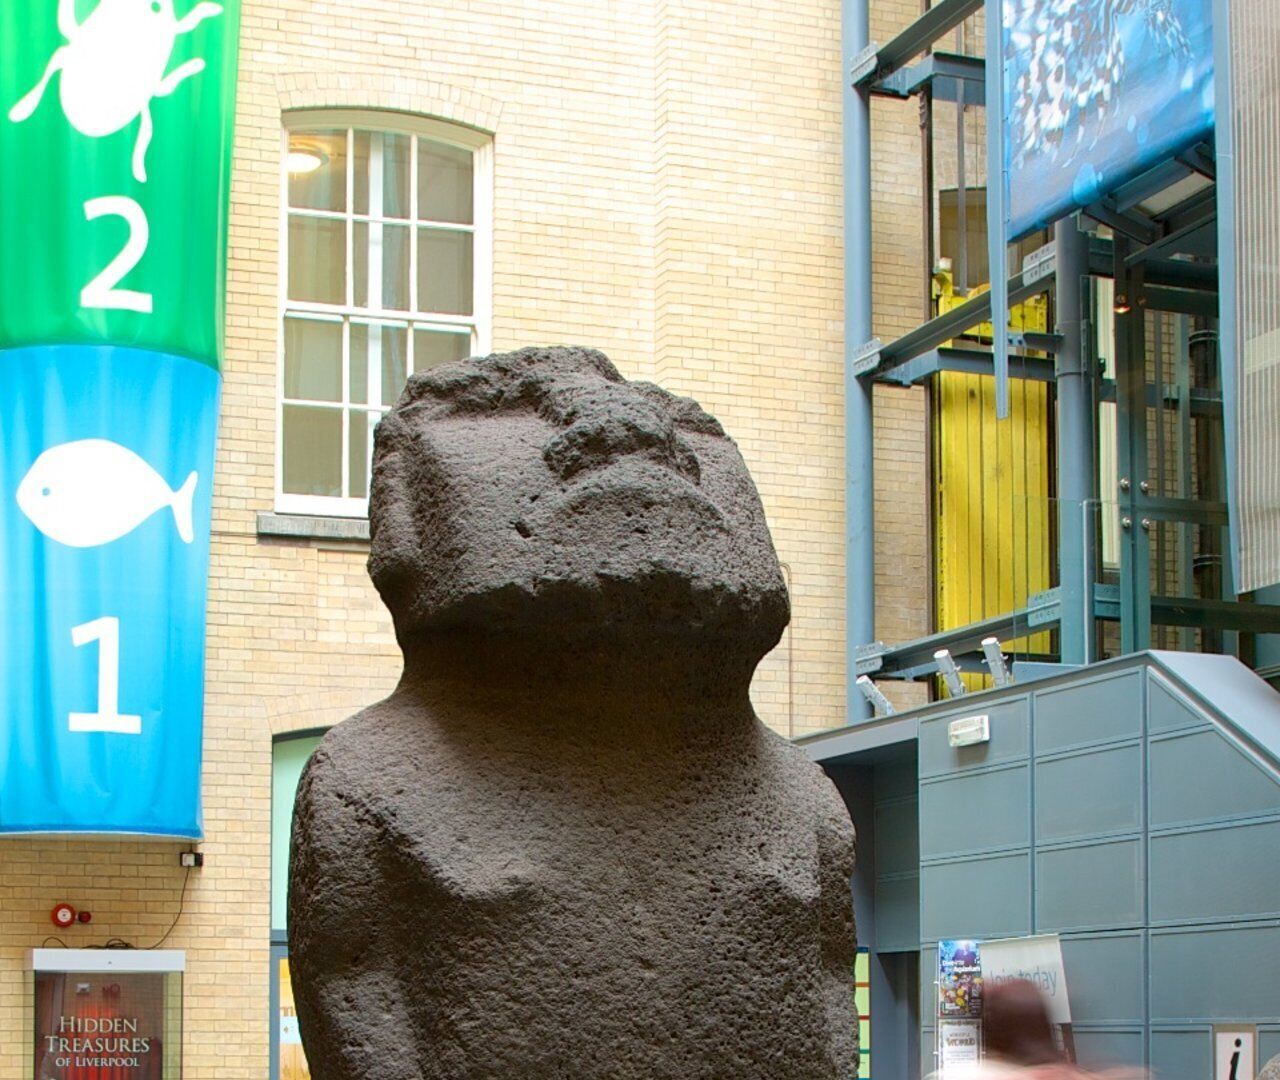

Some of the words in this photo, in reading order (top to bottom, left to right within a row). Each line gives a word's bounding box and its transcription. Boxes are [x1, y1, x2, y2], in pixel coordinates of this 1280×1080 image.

[79, 195, 153, 314] 2
[67, 615, 141, 735] 1
[59, 1016, 138, 1033] HIDDEN
[44, 1035, 150, 1054] TREASURES
[55, 1057, 72, 1067] OF
[75, 1056, 140, 1068] LIVERPOOL
